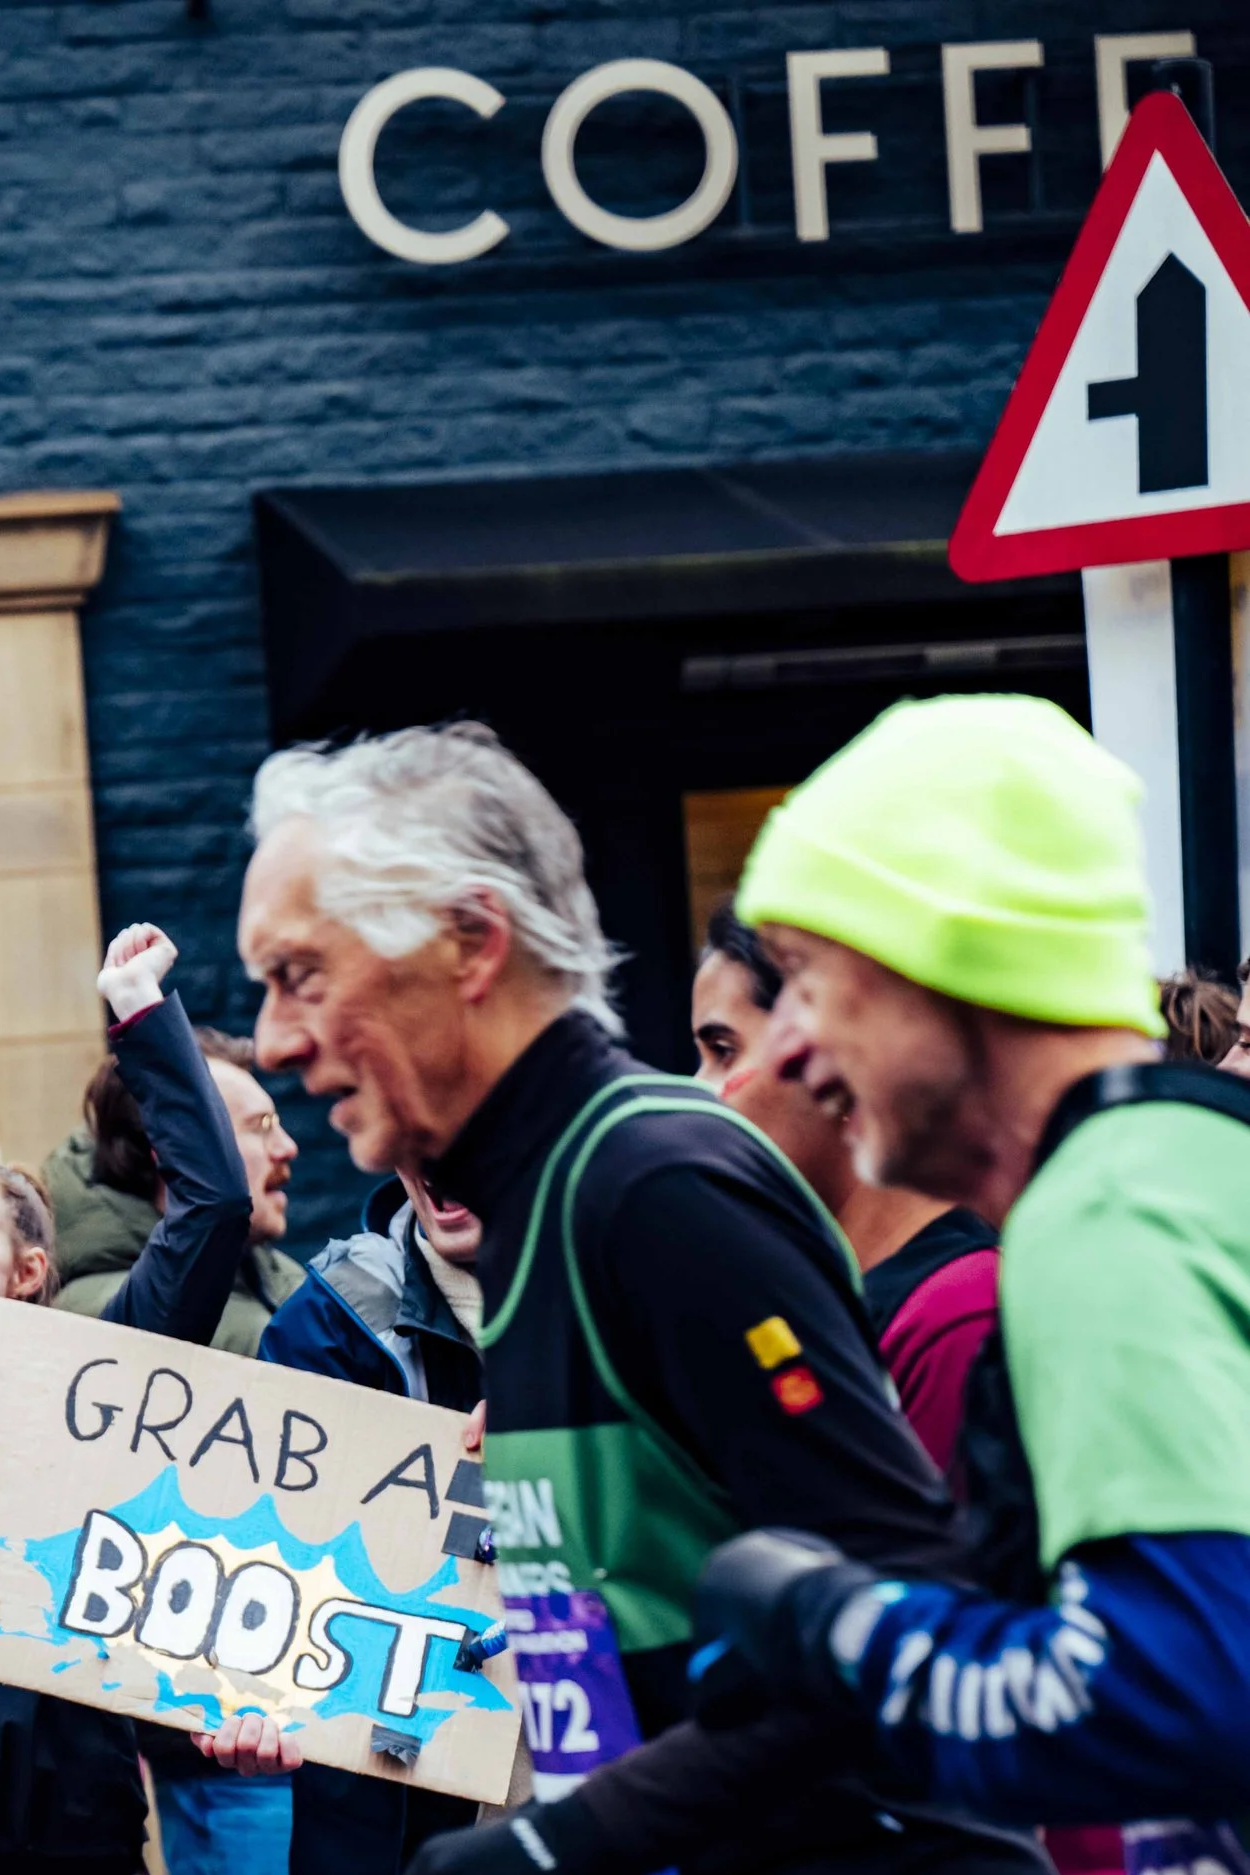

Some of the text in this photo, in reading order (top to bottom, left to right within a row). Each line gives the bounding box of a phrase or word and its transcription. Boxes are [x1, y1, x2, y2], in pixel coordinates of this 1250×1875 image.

[66, 1359, 440, 1520] GRAB A
[57, 1508, 472, 1717] BOOST
